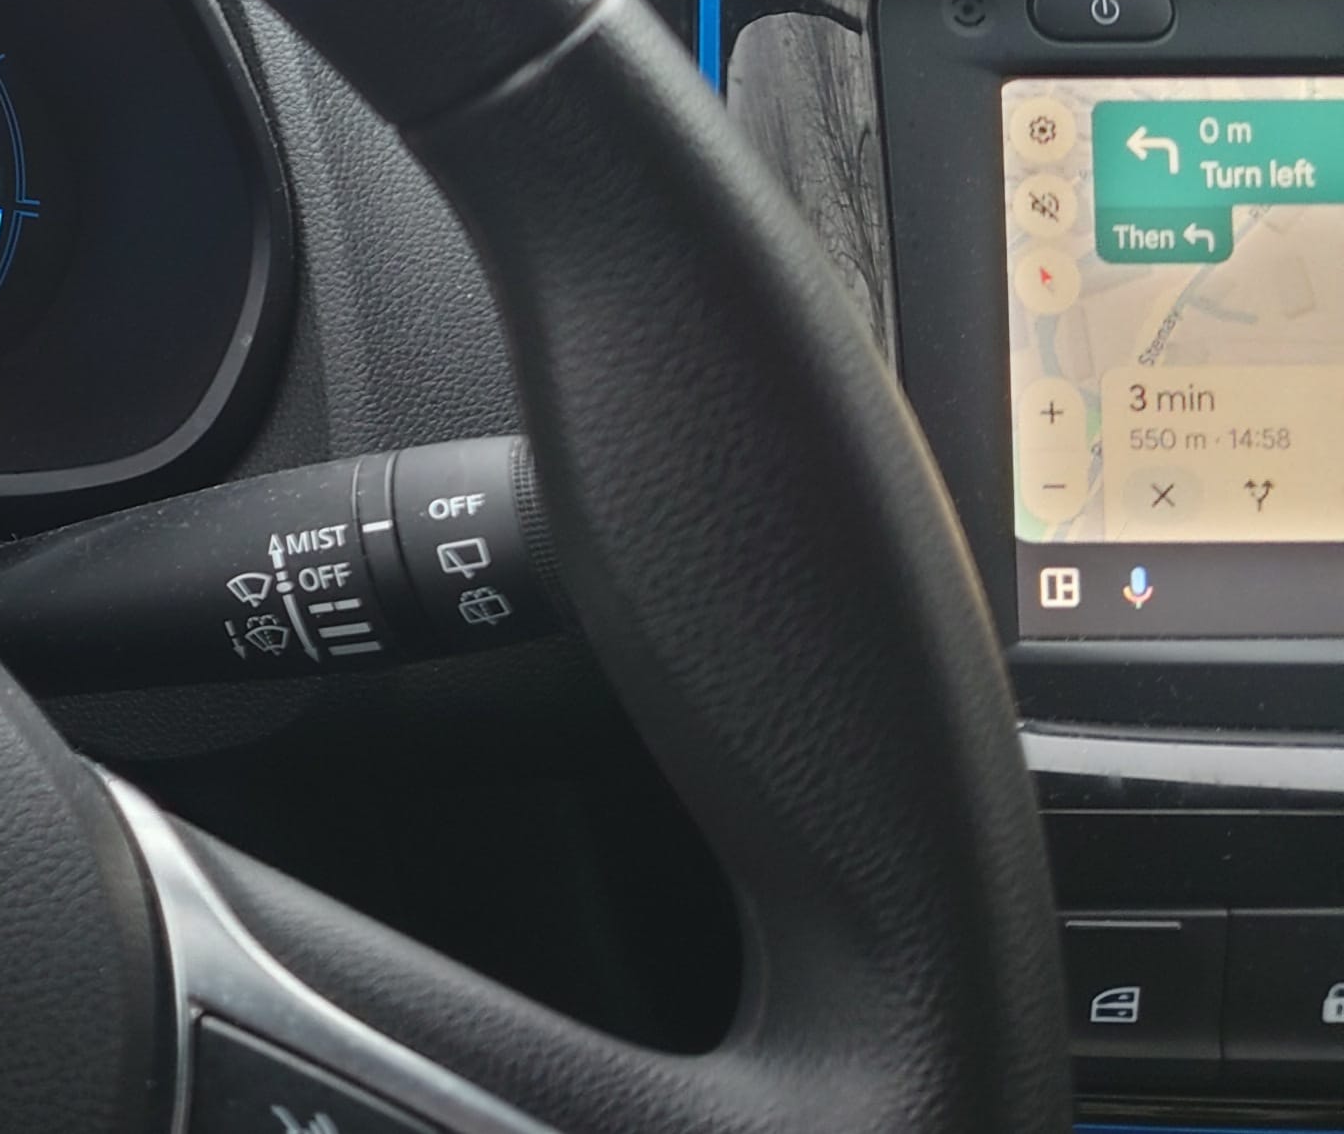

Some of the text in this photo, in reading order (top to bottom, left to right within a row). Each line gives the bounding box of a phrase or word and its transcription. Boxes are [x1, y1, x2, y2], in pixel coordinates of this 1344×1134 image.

[1199, 116, 1252, 144] 0 m
[1200, 158, 1316, 189] Turn left
[1112, 223, 1175, 249] Then
[1129, 383, 1216, 412] 3 min
[1129, 427, 1177, 450] 550
[1185, 431, 1207, 450] m
[1229, 427, 1292, 450] 14:58
[427, 493, 487, 521] OFF
[284, 523, 349, 556] MIST
[297, 561, 352, 592] OFF
